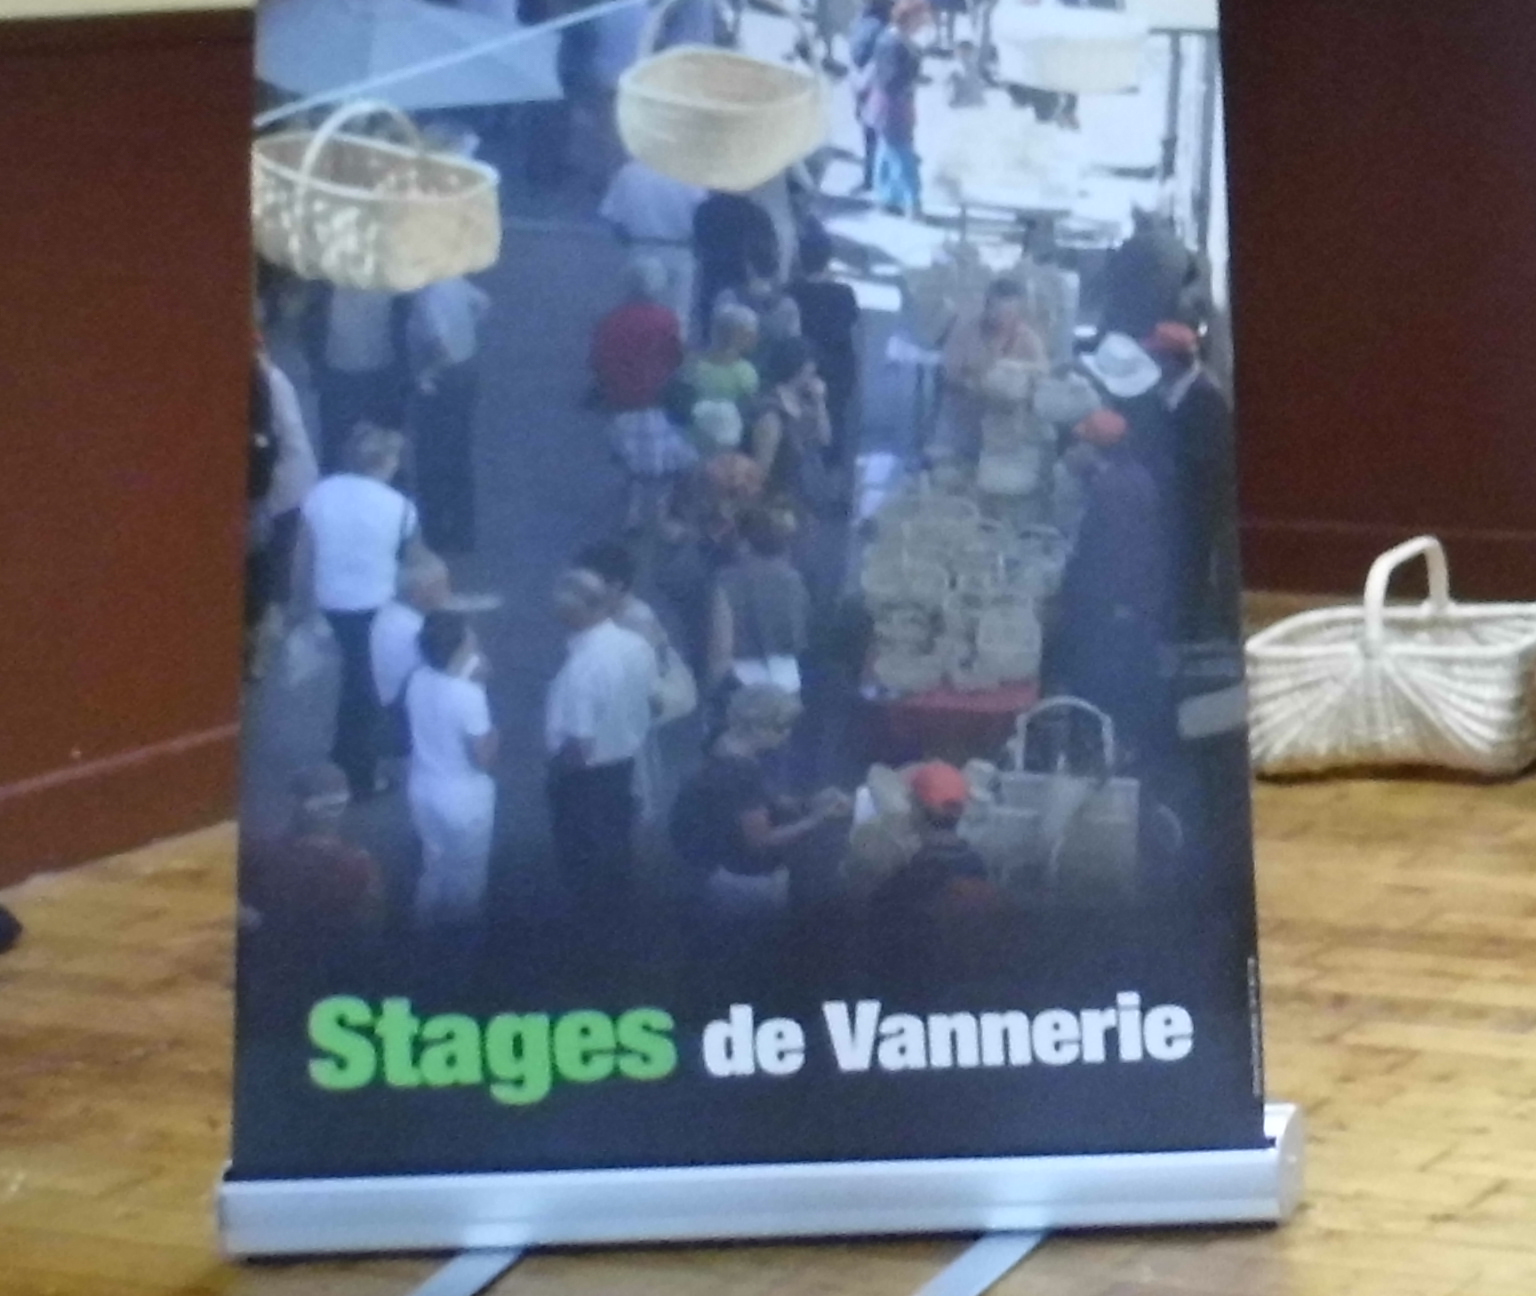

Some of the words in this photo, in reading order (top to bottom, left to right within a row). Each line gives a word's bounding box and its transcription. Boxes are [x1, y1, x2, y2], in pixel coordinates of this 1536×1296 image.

[308, 995, 679, 1105] Stages
[701, 1003, 806, 1079] de
[822, 990, 1195, 1073] Vannerie
